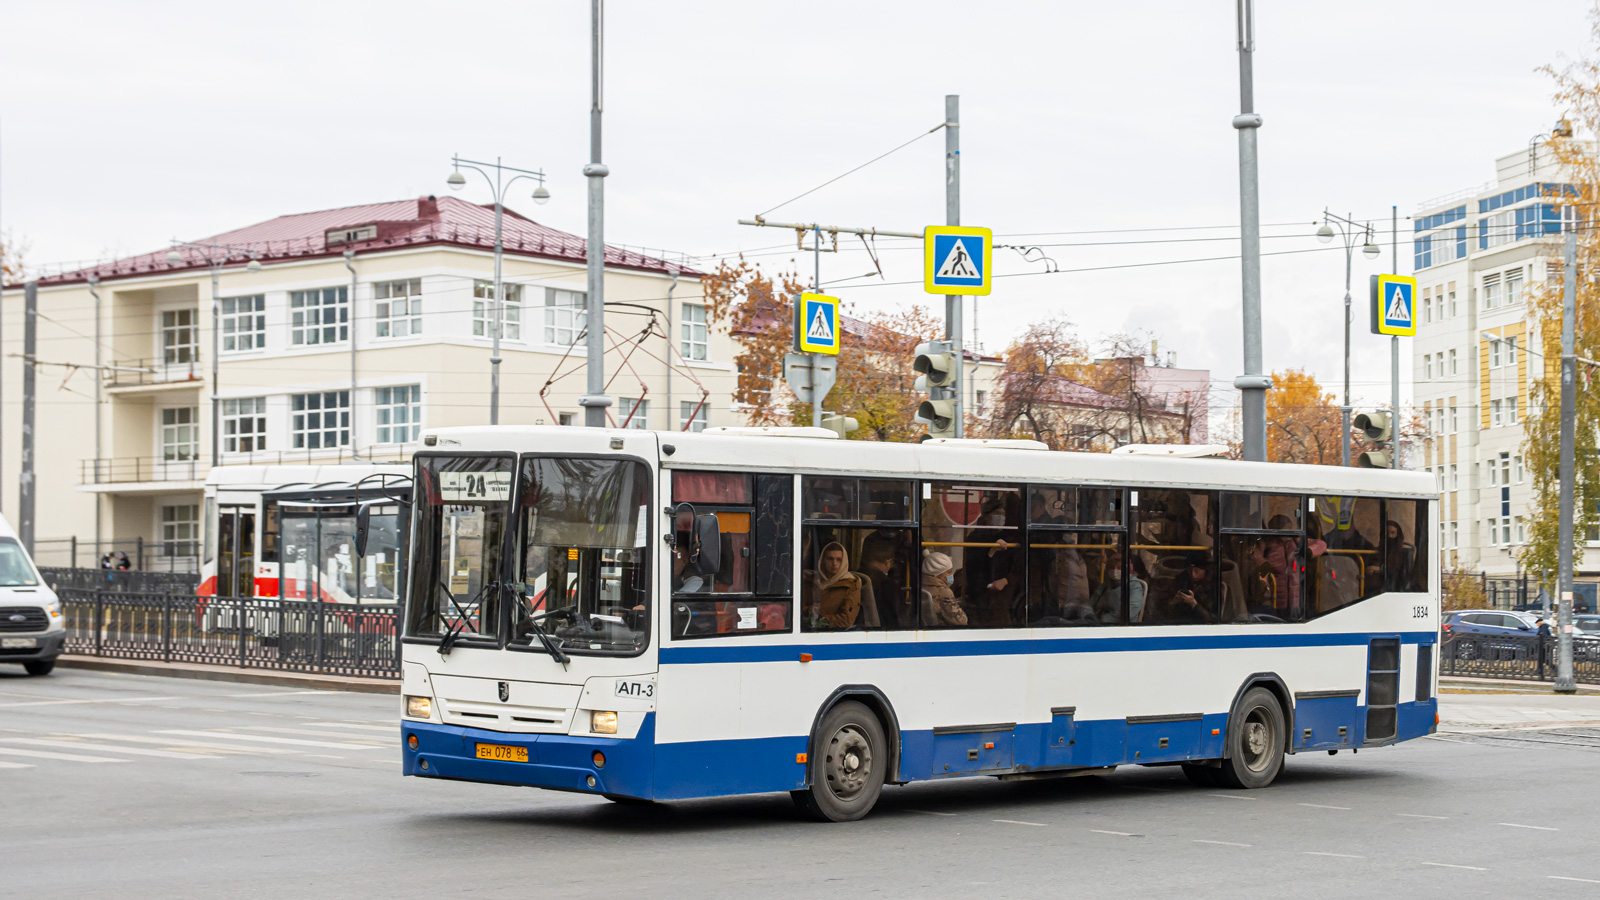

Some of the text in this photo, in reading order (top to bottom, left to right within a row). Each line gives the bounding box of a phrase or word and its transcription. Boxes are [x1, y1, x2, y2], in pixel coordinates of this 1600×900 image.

[466, 474, 486, 497] 24
[1413, 606, 1428, 618] 1834
[618, 681, 653, 697] АП-3
[495, 746, 511, 758] 078
[516, 747, 526, 757] 66
